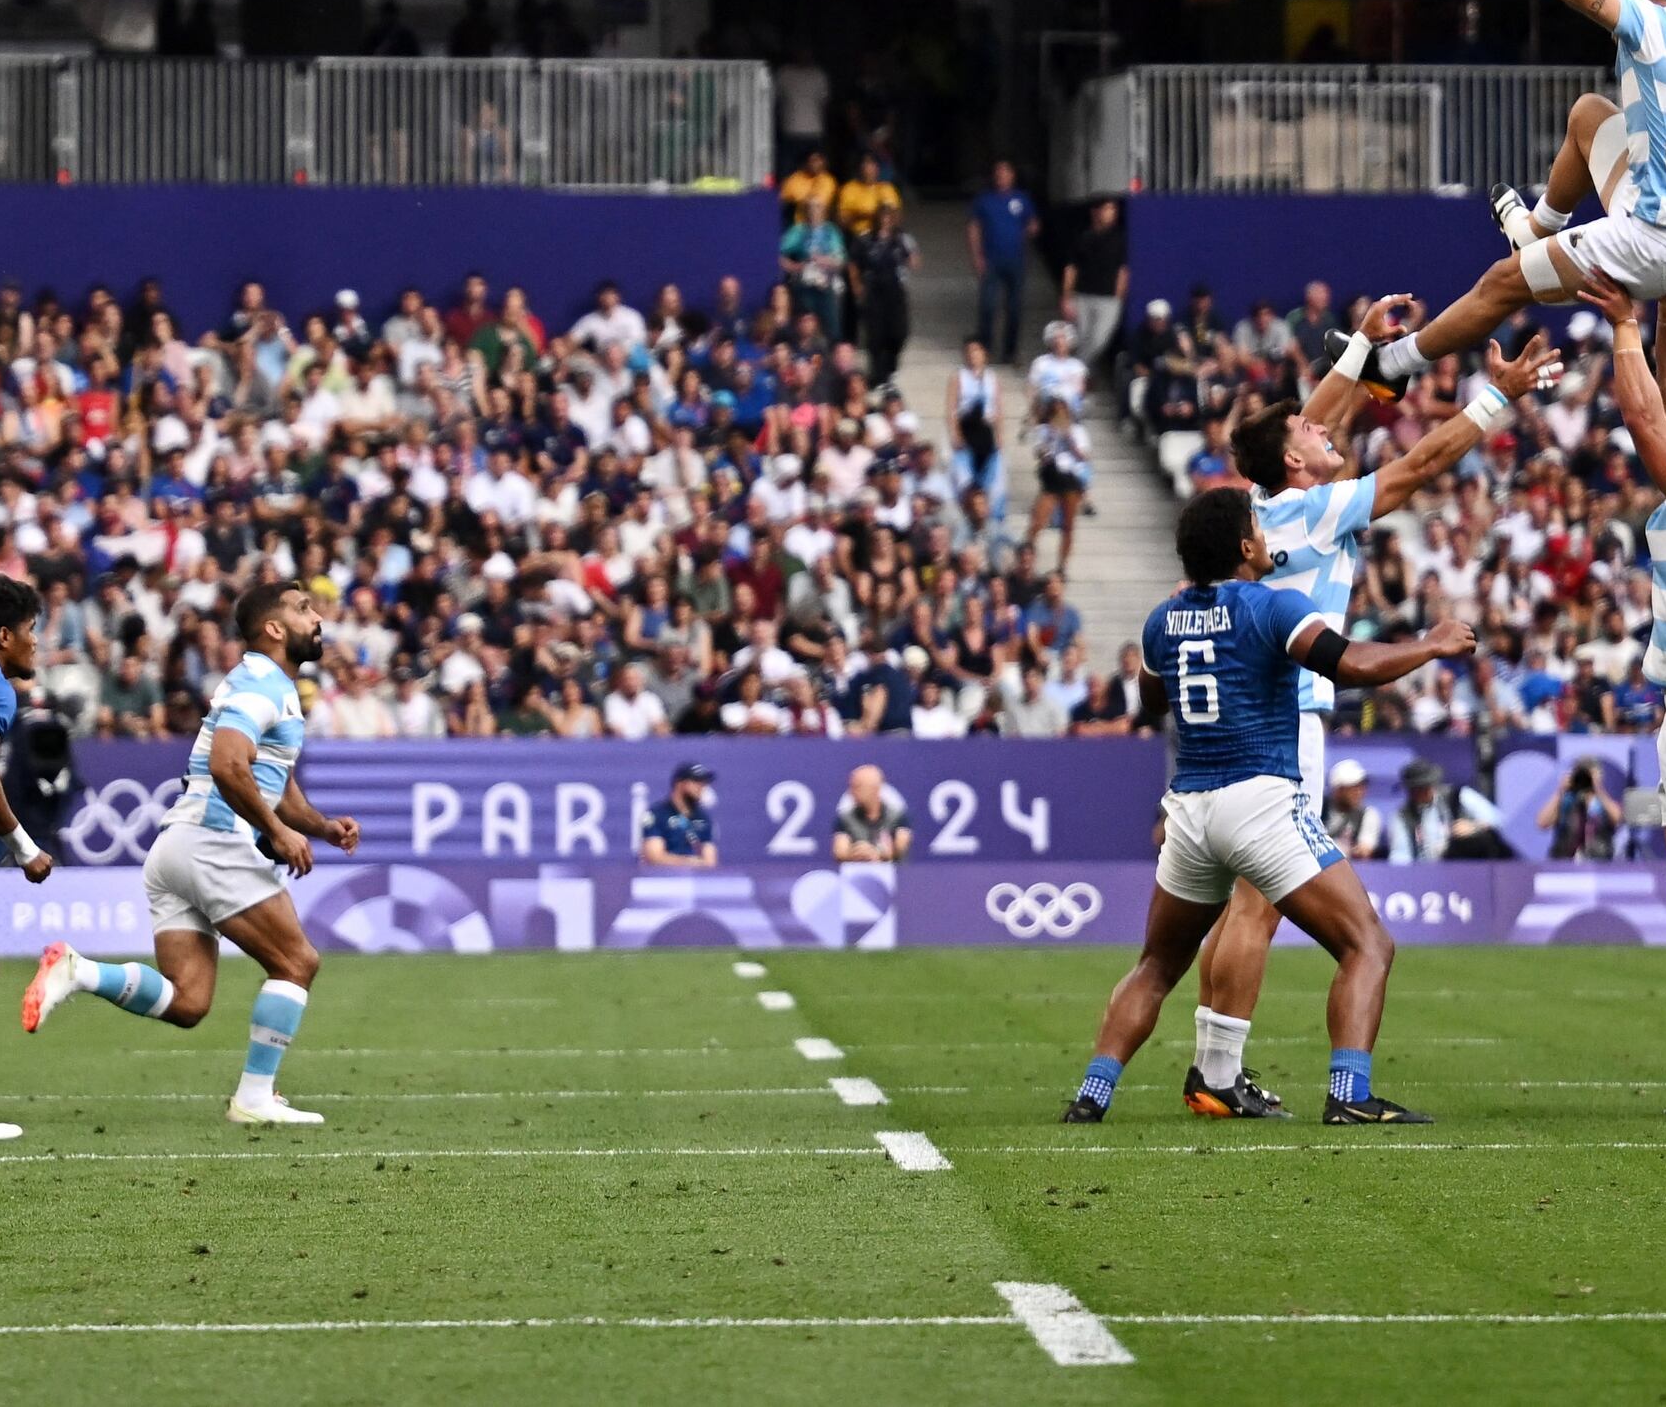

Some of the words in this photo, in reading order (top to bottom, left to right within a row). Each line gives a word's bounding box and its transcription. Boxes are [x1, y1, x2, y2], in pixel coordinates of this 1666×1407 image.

[1177, 639, 1220, 724] 6
[412, 781, 719, 857] PARI
[13, 901, 138, 930] PARIS
